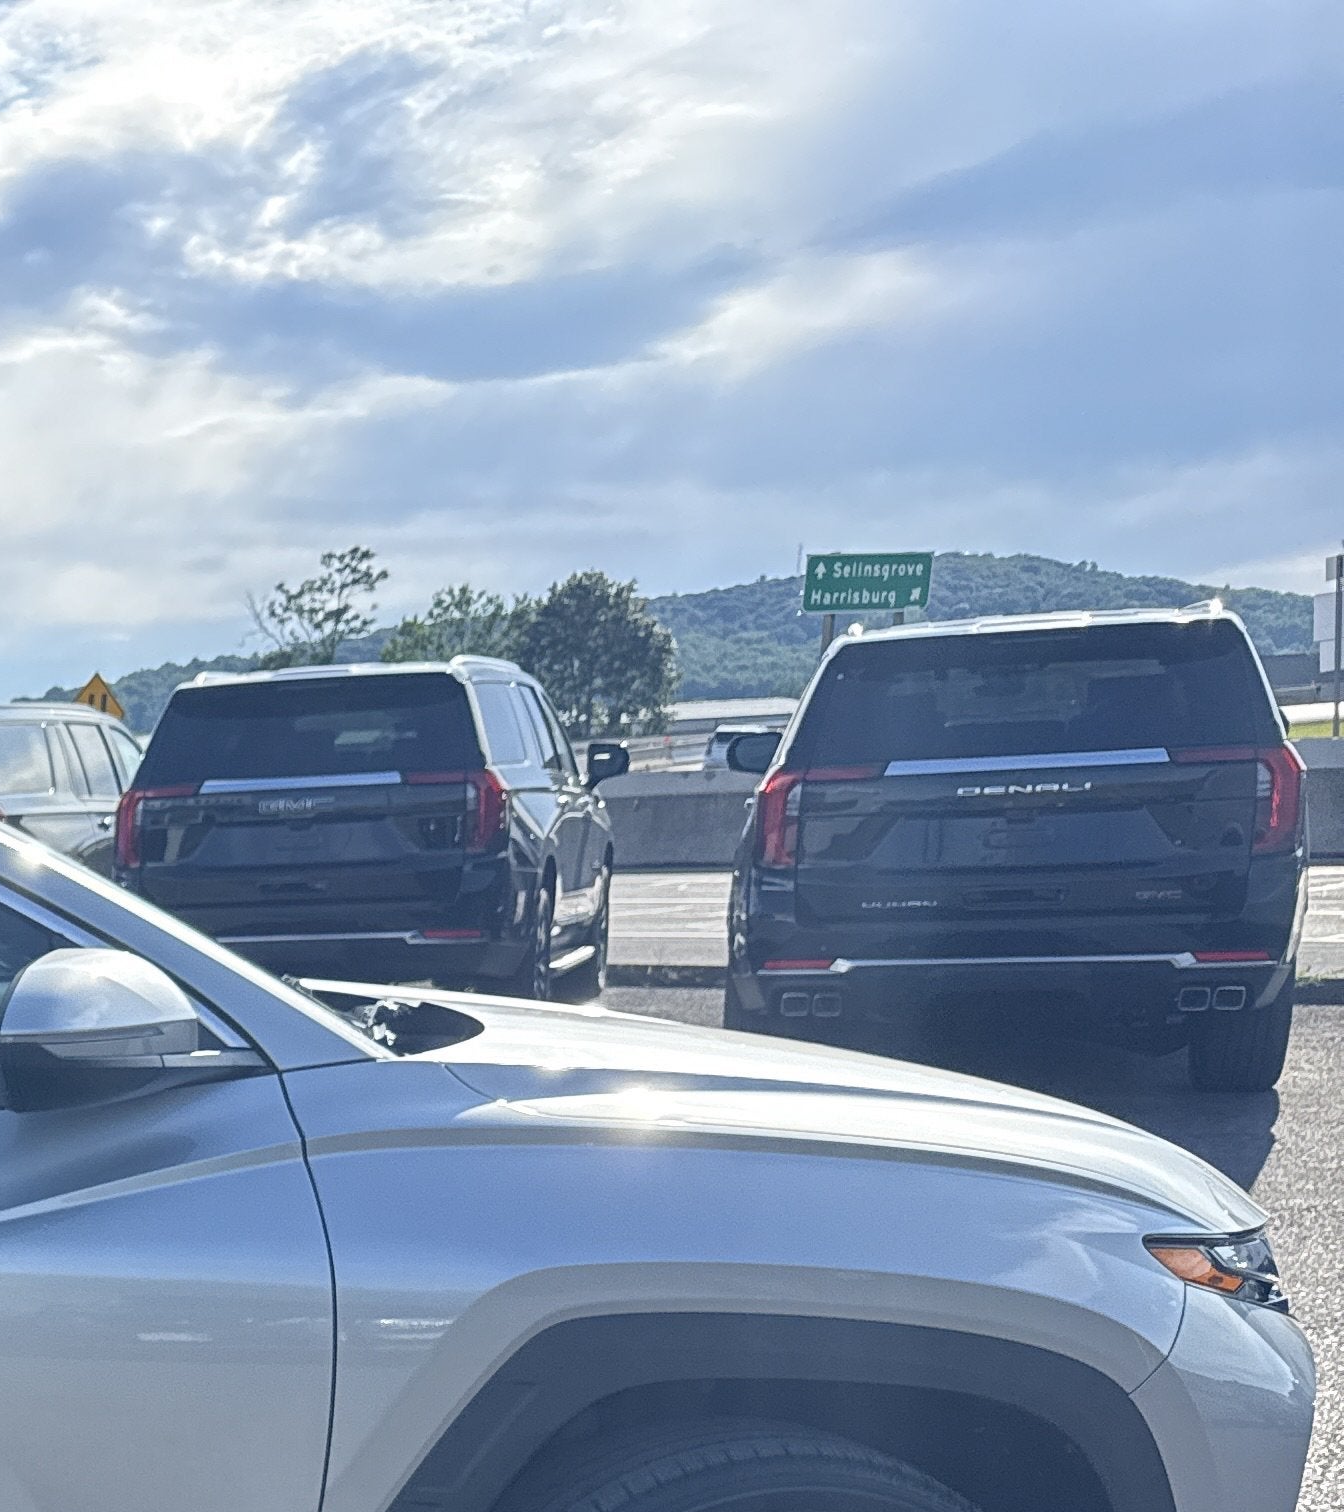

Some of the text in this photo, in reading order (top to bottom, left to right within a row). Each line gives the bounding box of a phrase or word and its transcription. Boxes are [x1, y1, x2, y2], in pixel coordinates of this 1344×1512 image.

[832, 561, 924, 582] Selinsgrove
[810, 588, 897, 608] Harrisburg
[957, 781, 1092, 797] DENALI
